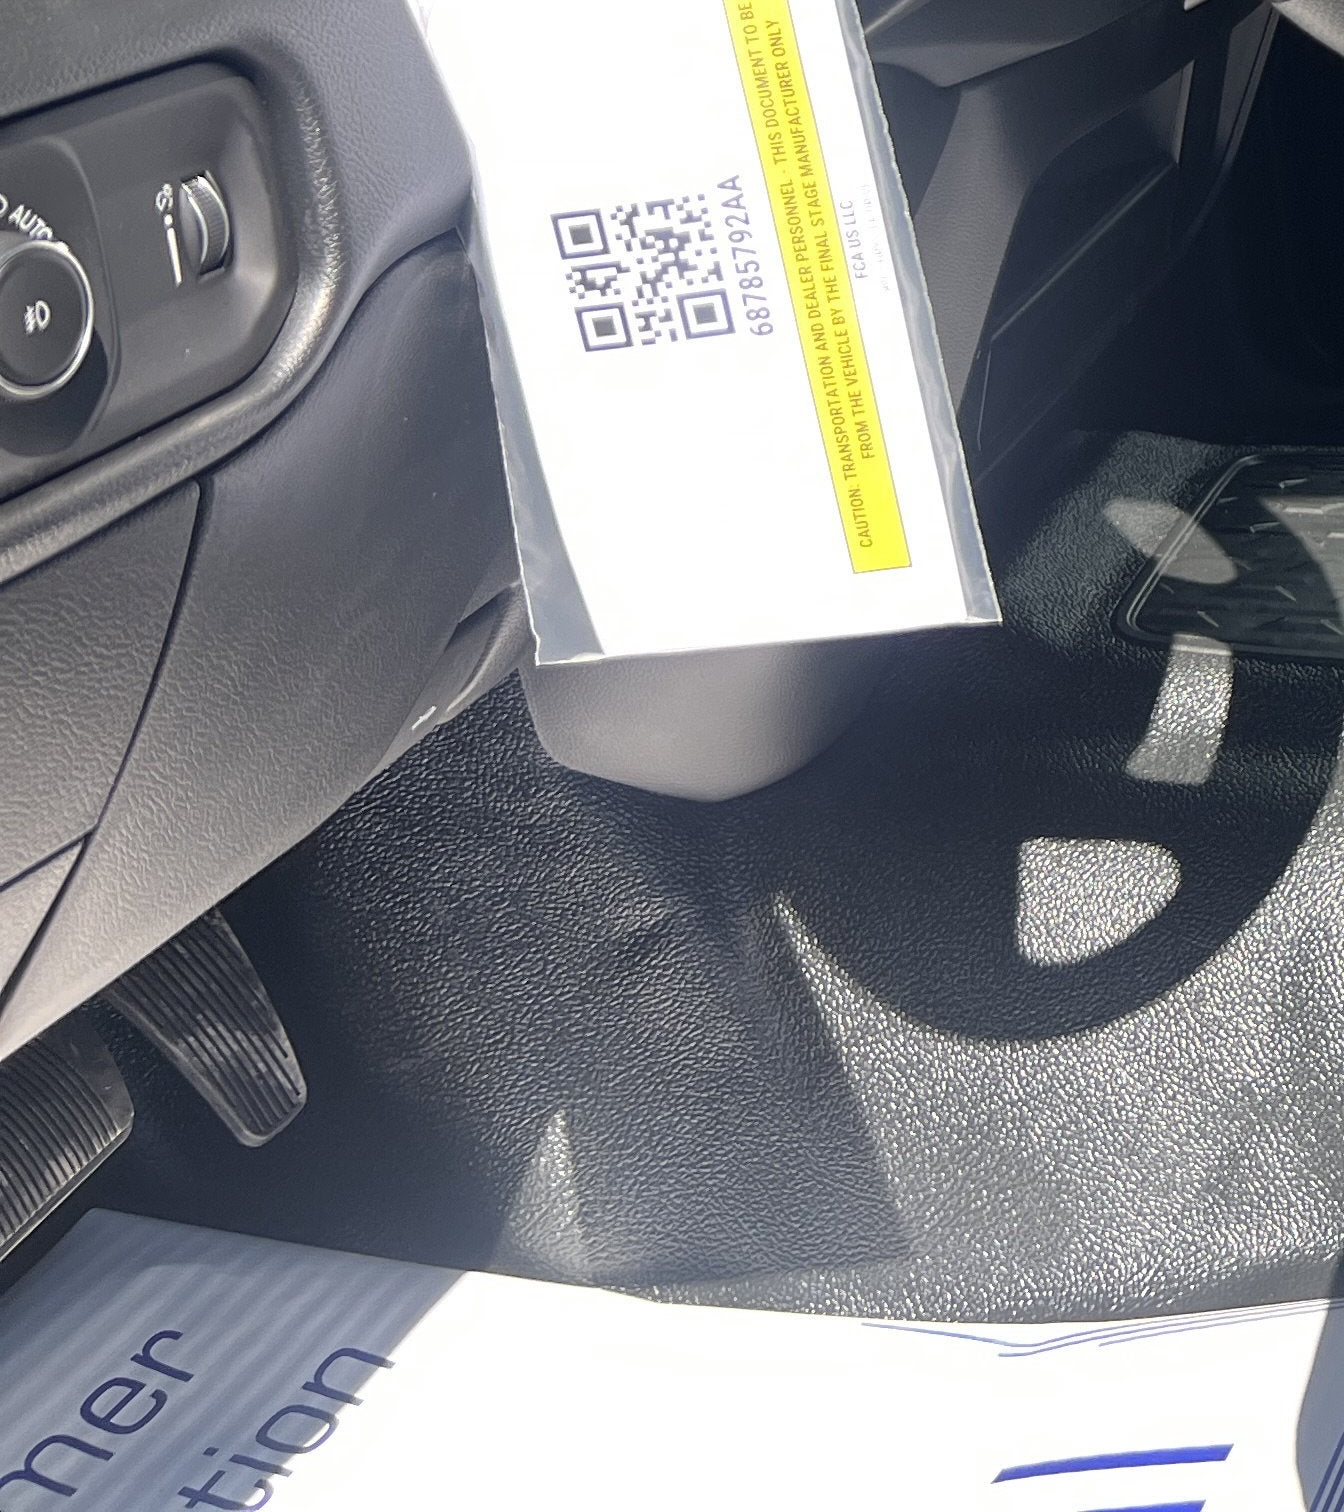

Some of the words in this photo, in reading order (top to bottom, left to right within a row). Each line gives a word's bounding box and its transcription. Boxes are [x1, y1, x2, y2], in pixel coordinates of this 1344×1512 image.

[739, 1, 755, 21] BE
[743, 24, 759, 45] TO
[766, 20, 786, 58] ONLY
[748, 49, 780, 129] DOCUMENT
[777, 60, 813, 177] MANUFACTURER
[768, 131, 788, 165] THIS
[8, 203, 54, 240] AUTO
[780, 178, 810, 263] PERSONNEL
[802, 181, 825, 227] STAGE
[838, 199, 857, 226] LLC
[717, 174, 774, 336] 68785792AA
[814, 230, 835, 273] FINAL
[844, 227, 862, 249] US
[849, 251, 869, 279] FCA
[798, 265, 823, 320] DEALER
[823, 275, 841, 303] THE
[830, 308, 846, 326] BY
[811, 322, 829, 351] AND
[835, 329, 858, 387] VEHICLE
[818, 354, 858, 481] TRANSPORTATION
[848, 390, 866, 417] THE
[854, 420, 876, 460] FROM
[177, 1347, 396, 1512] tion
